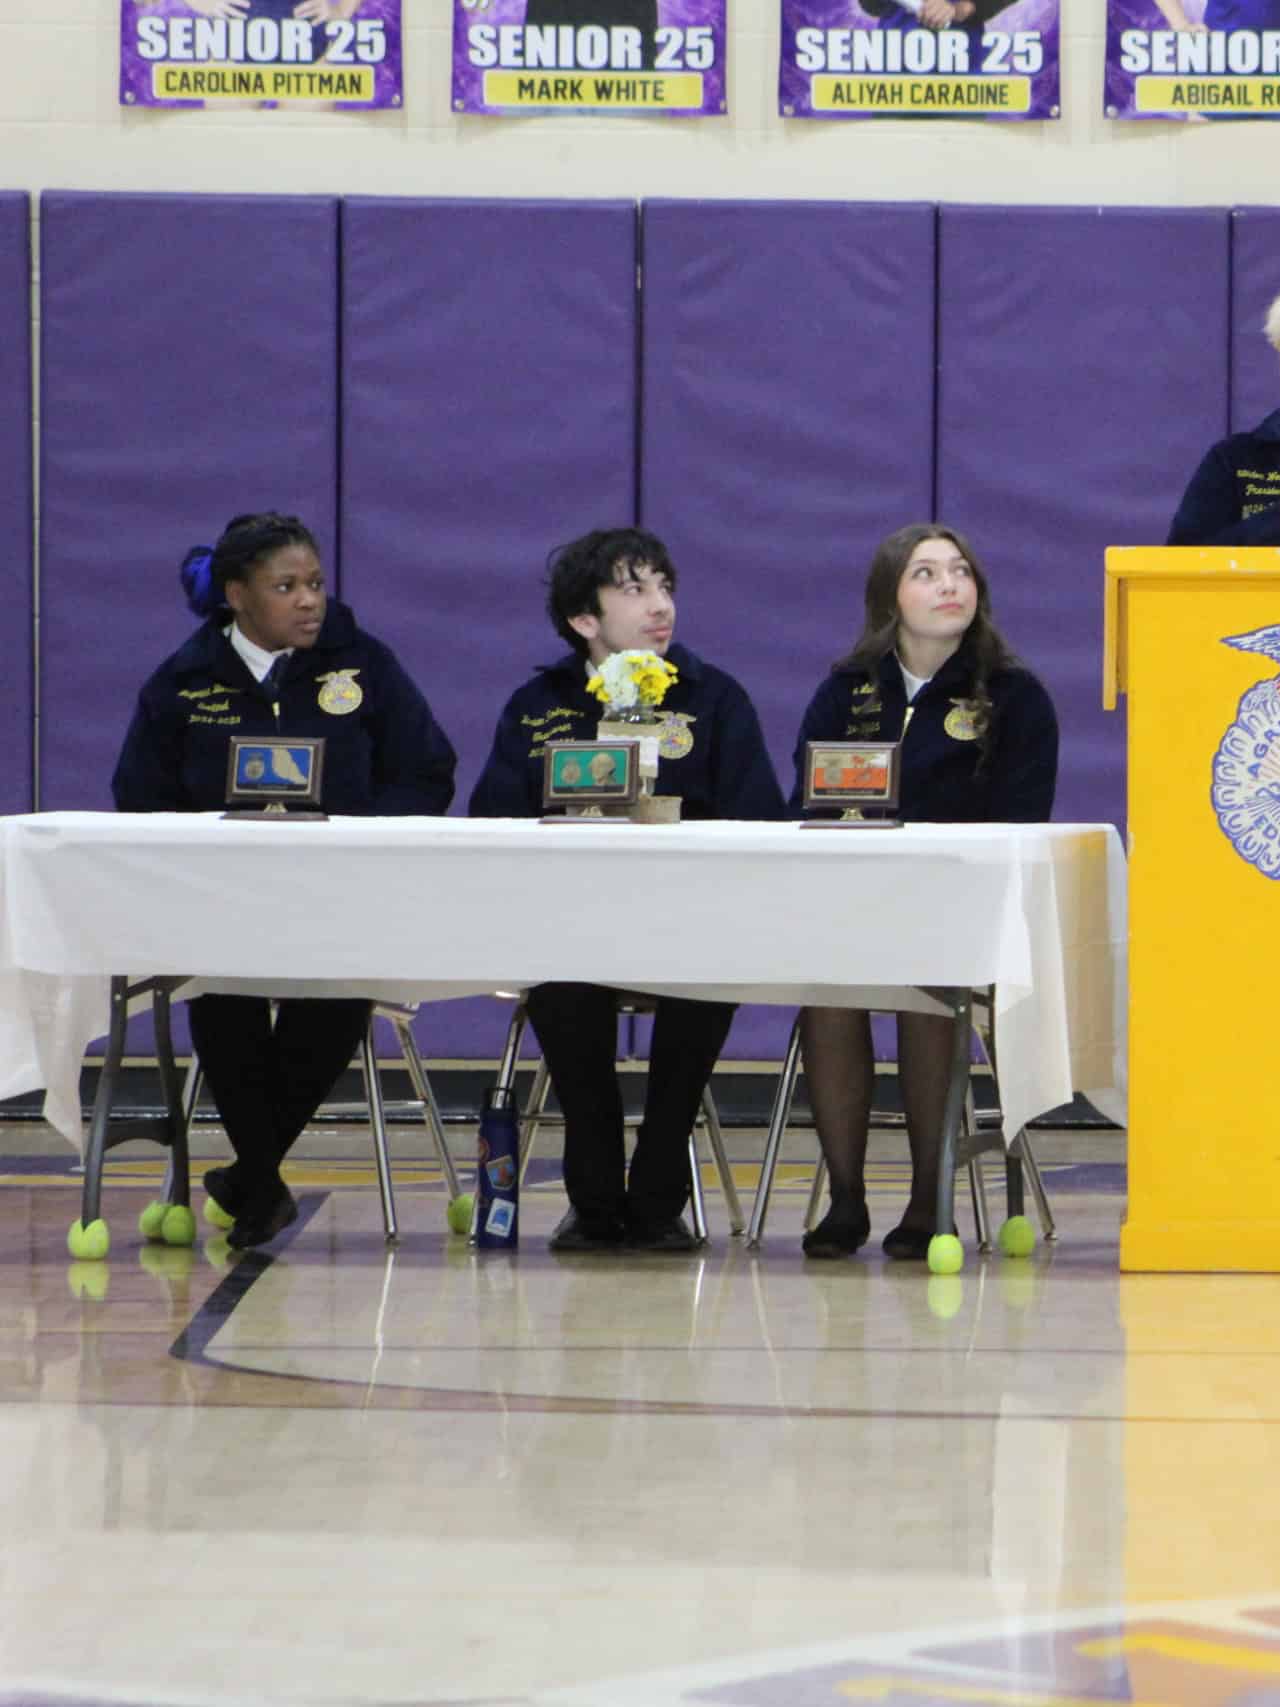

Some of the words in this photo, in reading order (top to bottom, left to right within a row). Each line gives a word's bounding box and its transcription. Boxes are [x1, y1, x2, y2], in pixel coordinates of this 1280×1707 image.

[137, 16, 313, 62] SENIOR
[323, 17, 386, 62] 25
[469, 24, 642, 69] SENIOR
[653, 25, 715, 70] 25
[796, 28, 970, 72] SENIOR
[981, 30, 1043, 73] 25
[165, 71, 264, 93] CAROLINA
[273, 72, 362, 94] PITTMAN
[518, 79, 584, 101] MARK
[594, 80, 665, 101] WHITE
[832, 83, 903, 104] ALIYAH
[910, 84, 1009, 105] CARADINE
[1172, 85, 1253, 105] ABIGAIL
